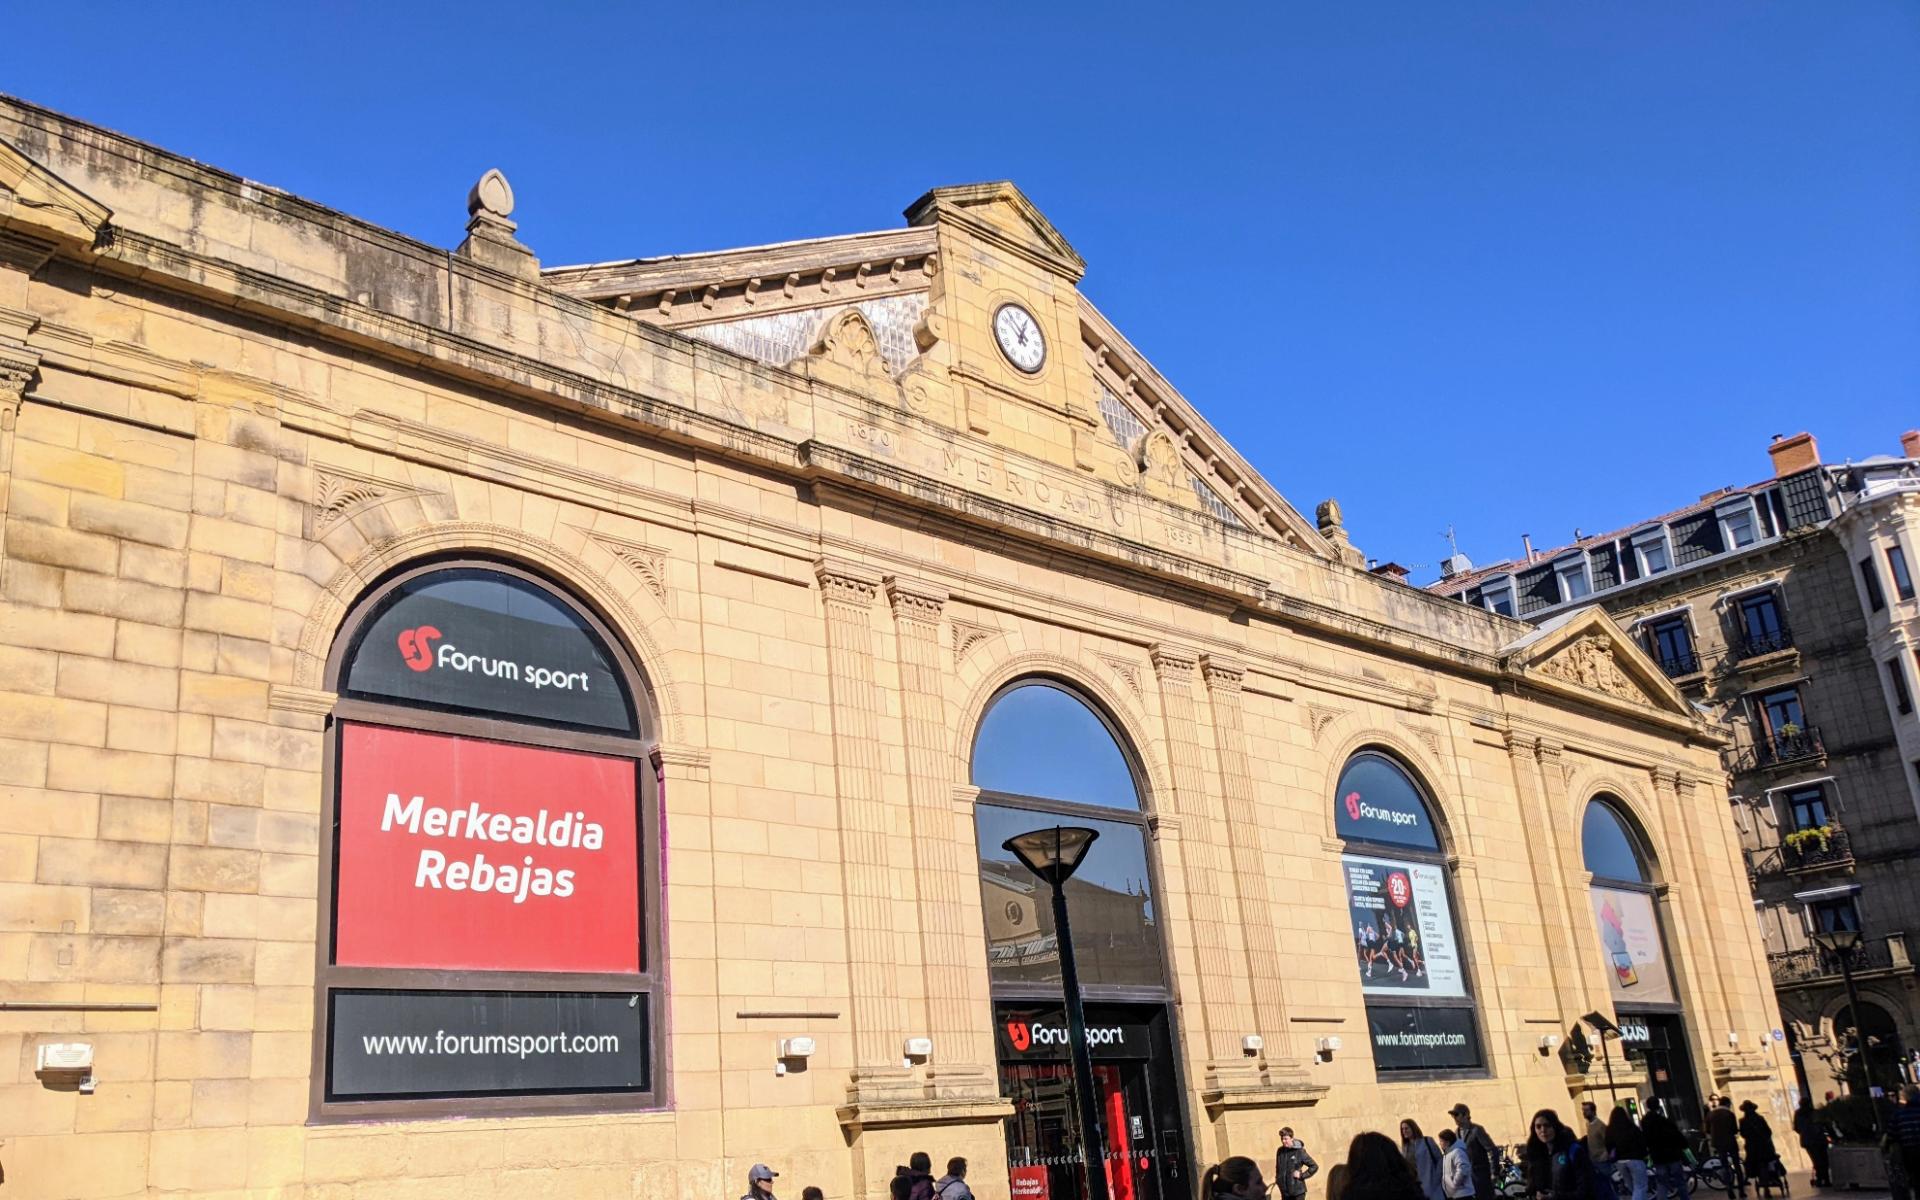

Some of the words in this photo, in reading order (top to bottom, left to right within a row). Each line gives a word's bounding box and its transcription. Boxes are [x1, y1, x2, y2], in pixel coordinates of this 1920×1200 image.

[849, 423, 890, 447] 1870
[942, 446, 1125, 528] MERCADO
[524, 665, 589, 692] sport
[380, 793, 604, 851] Merkealdia
[1391, 811, 1418, 826] sport
[414, 849, 576, 904] Rebajas
[362, 1028, 620, 1060] www.forumsport.com
[1375, 1031, 1466, 1049] www.forumsport.com
